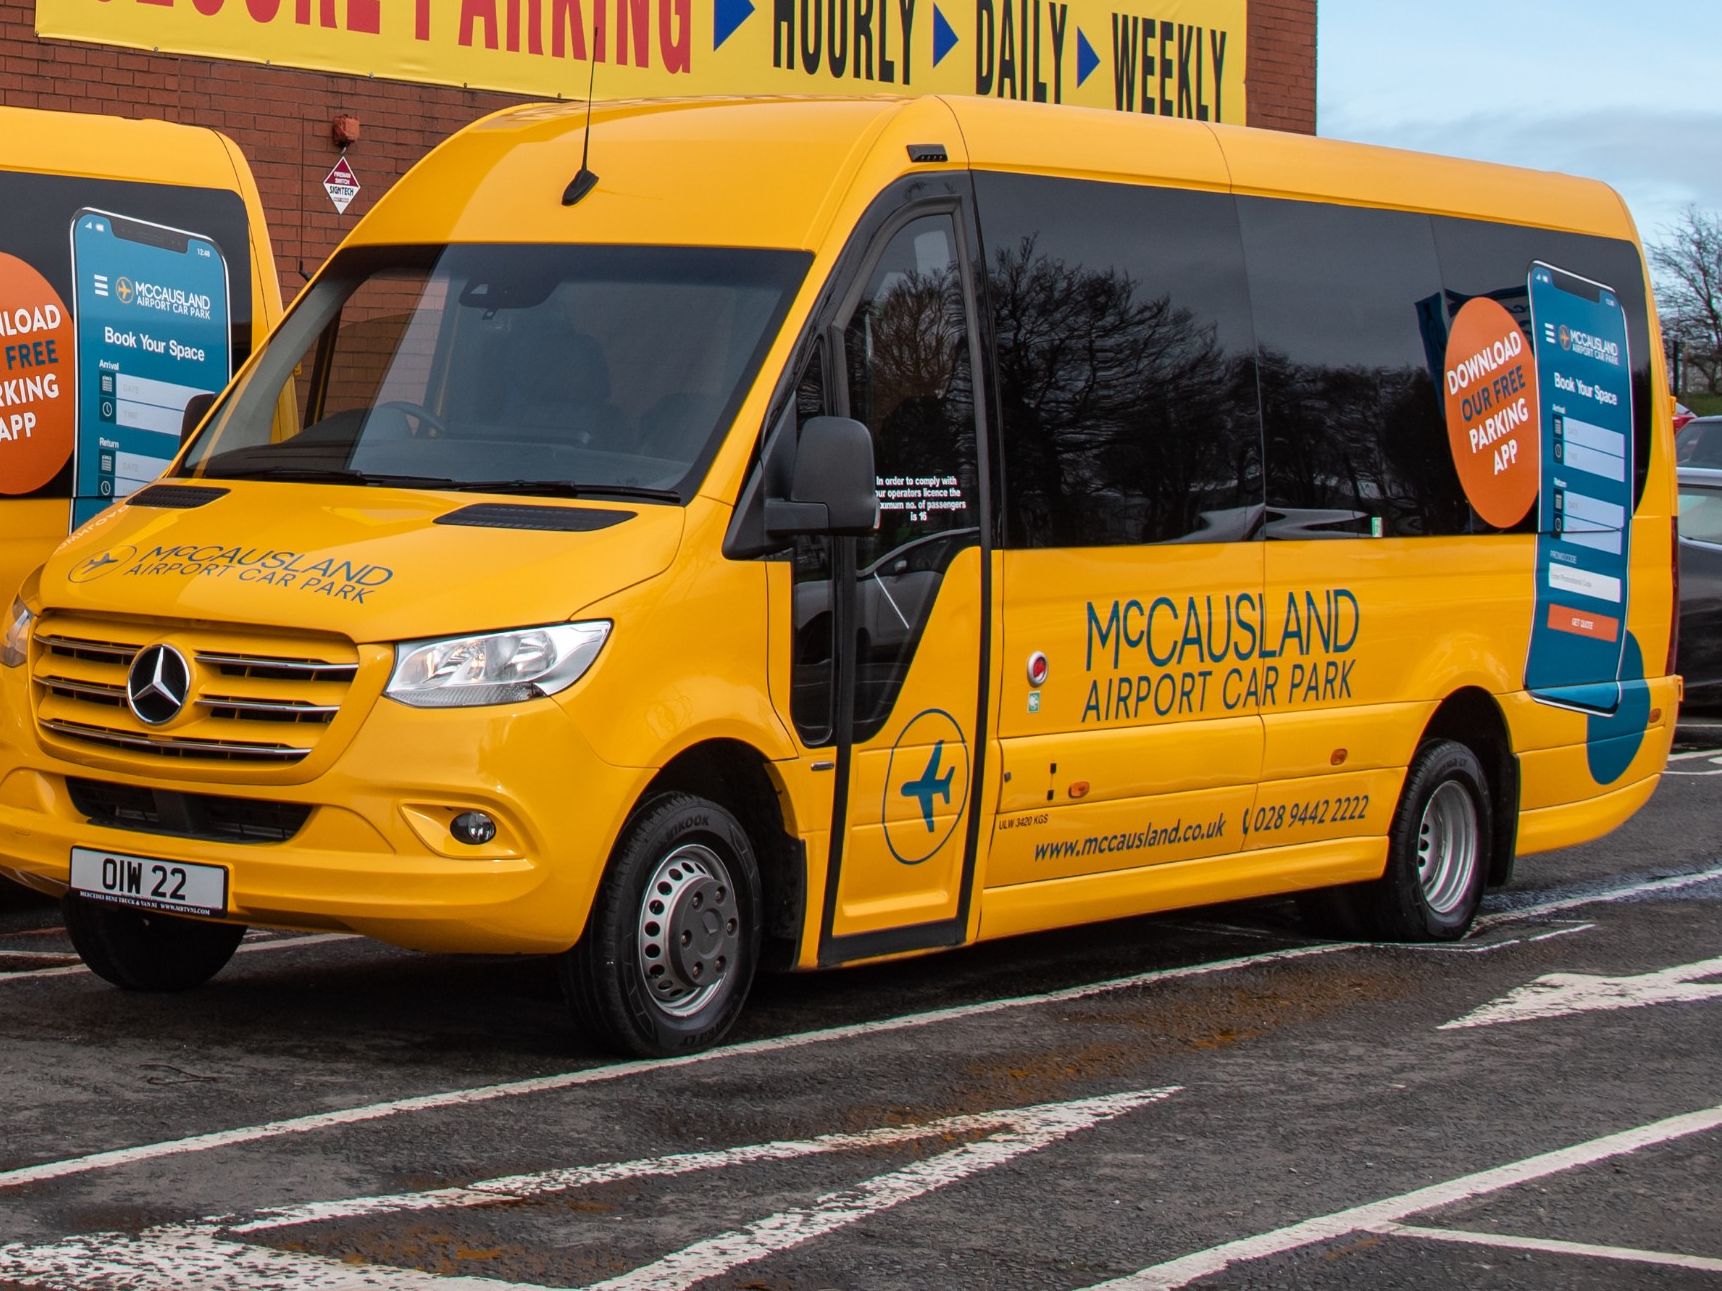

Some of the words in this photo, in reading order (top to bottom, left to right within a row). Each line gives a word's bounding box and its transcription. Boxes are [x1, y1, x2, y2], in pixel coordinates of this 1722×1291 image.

[1112, 12, 1227, 123] WEEKLY
[137, 296, 170, 311] AIRPORT
[173, 303, 188, 316] CAR
[190, 308, 210, 320] PARK
[6, 339, 59, 370] FREE
[104, 326, 137, 348] Book
[140, 333, 165, 353] Your
[169, 339, 205, 361] Space
[99, 359, 119, 371] Arrival
[1446, 330, 1522, 395] DOWNLOAD
[1461, 386, 1492, 422] OUR
[1492, 364, 1526, 402] FREE
[1554, 371, 1576, 393] Book
[1575, 378, 1593, 398] Your
[1594, 384, 1618, 405] Space
[99, 437, 119, 448] Return
[1468, 397, 1529, 454] PARKING
[1492, 439, 1518, 476] APP
[876, 475, 883, 486] In
[885, 476, 904, 486] order
[905, 476, 914, 486] to
[915, 476, 940, 488] comply
[941, 475, 957, 486] with
[887, 488, 922, 499] operators
[923, 488, 948, 497] licence
[949, 488, 961, 497] the
[905, 501, 917, 509] no.
[918, 500, 926, 509] of
[926, 500, 966, 511] passengers
[910, 512, 918, 521] is
[919, 512, 927, 521] 16
[123, 562, 236, 578] AIRPORT
[239, 568, 297, 588] CAR
[300, 577, 375, 605] PARK
[139, 545, 394, 588] McCAUSLAND
[1085, 588, 1360, 671] McCAUSLAND
[1081, 669, 1213, 723] AIRPORT
[1222, 665, 1278, 709] CAR
[1288, 658, 1357, 704] PARK
[999, 818, 1014, 830] ULW
[1015, 816, 1033, 828] 3420
[1033, 813, 1049, 825] KGS
[1034, 811, 1227, 863] www.mccausland.co.uk
[1253, 803, 1285, 833] 028
[1288, 799, 1328, 830] 9442
[1329, 794, 1369, 825] 2222
[102, 858, 143, 895] OIW
[150, 864, 187, 901] 22
[79, 890, 105, 901] MERCEDES
[118, 896, 135, 906] TRUCK
[135, 898, 140, 906] &
[140, 899, 151, 908] VAN
